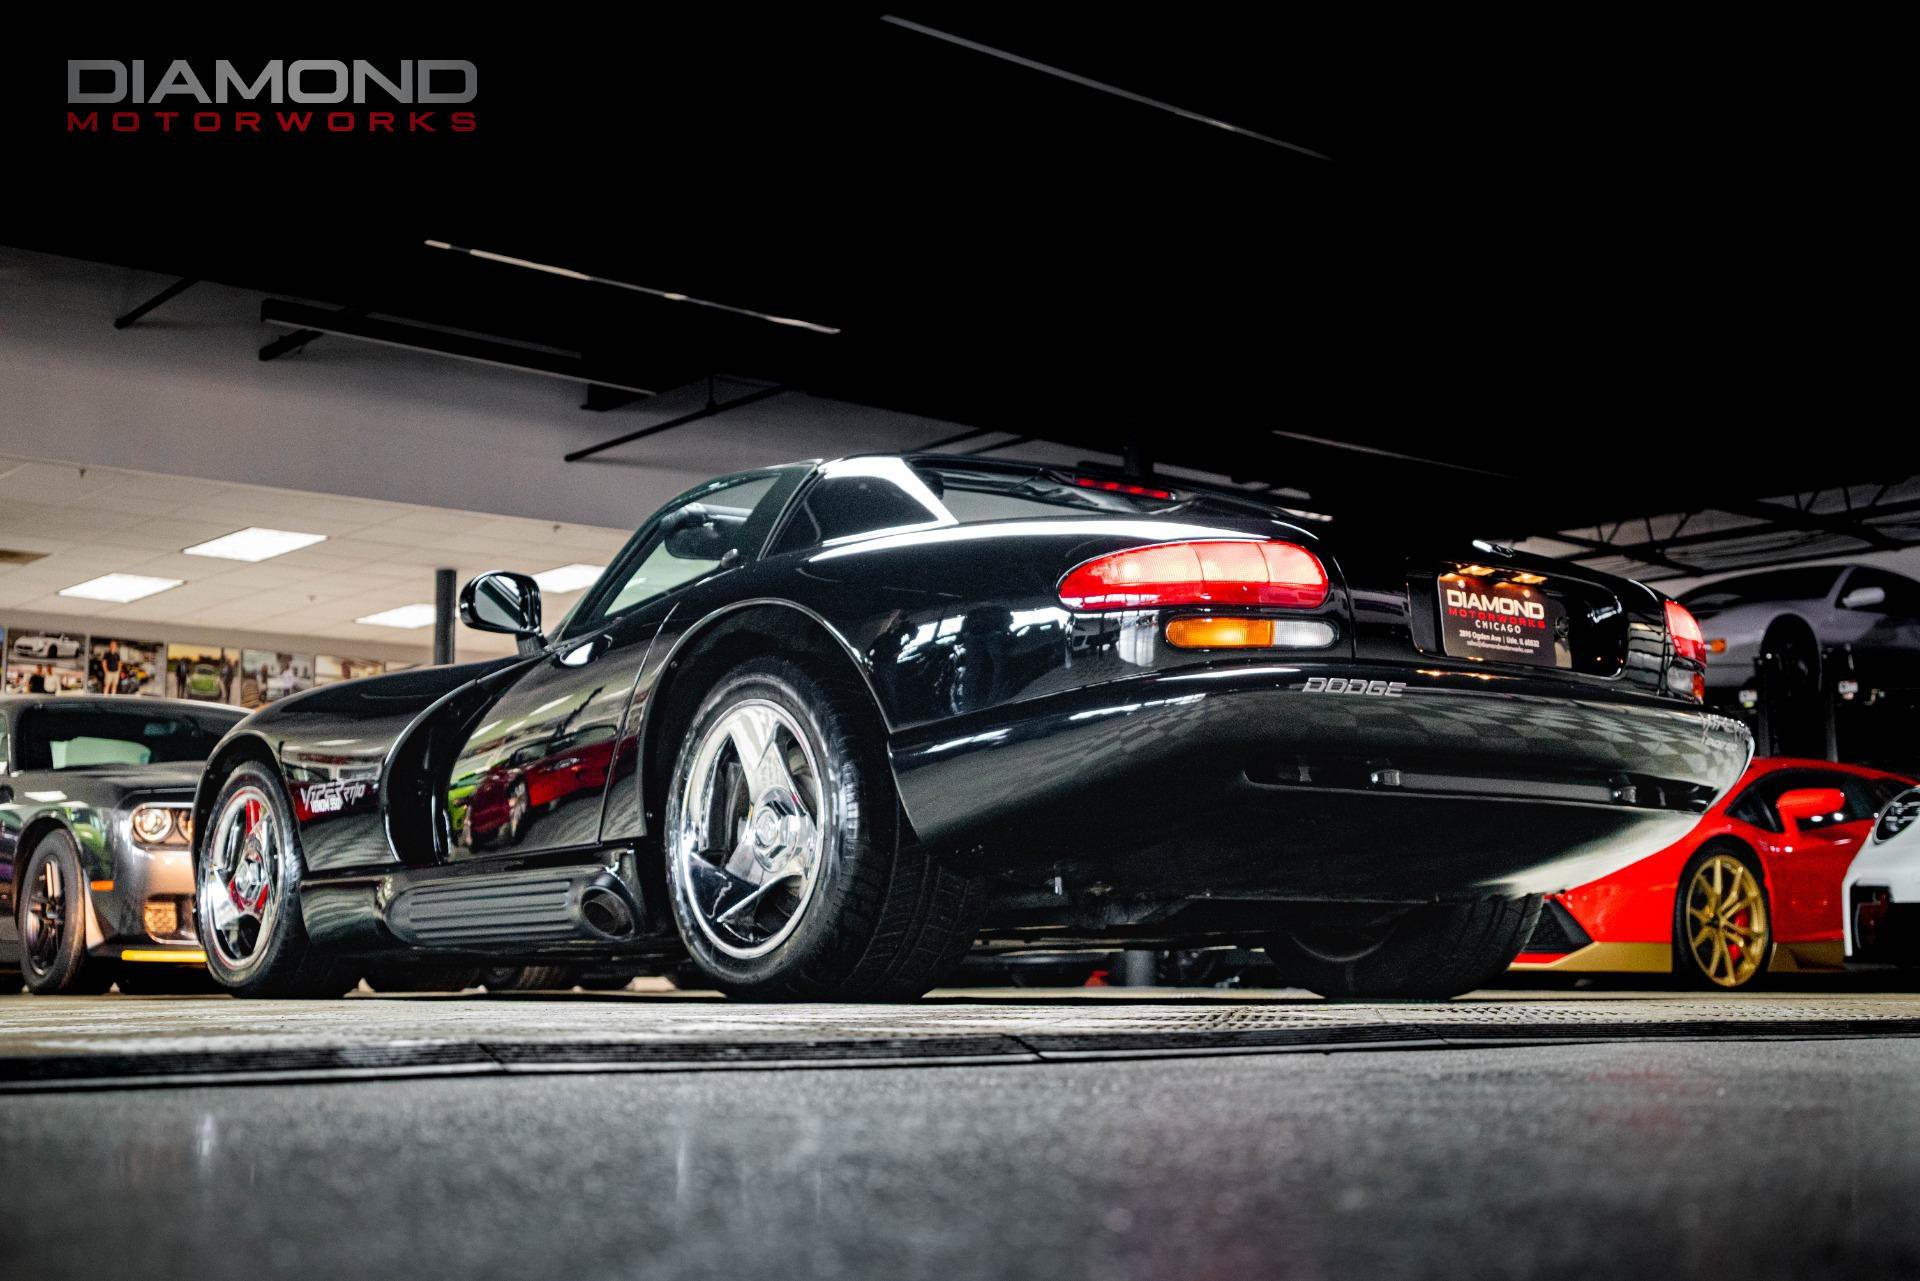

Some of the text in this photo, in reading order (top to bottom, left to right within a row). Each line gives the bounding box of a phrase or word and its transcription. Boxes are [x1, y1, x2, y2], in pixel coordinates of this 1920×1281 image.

[1446, 589, 1545, 620] DIAMOND
[1448, 608, 1546, 629] MOTORWORKS
[1475, 619, 1521, 634] CHICAGO
[1472, 631, 1490, 641] Ogden
[1490, 634, 1501, 642] Ave
[1302, 677, 1406, 697] DODGE
